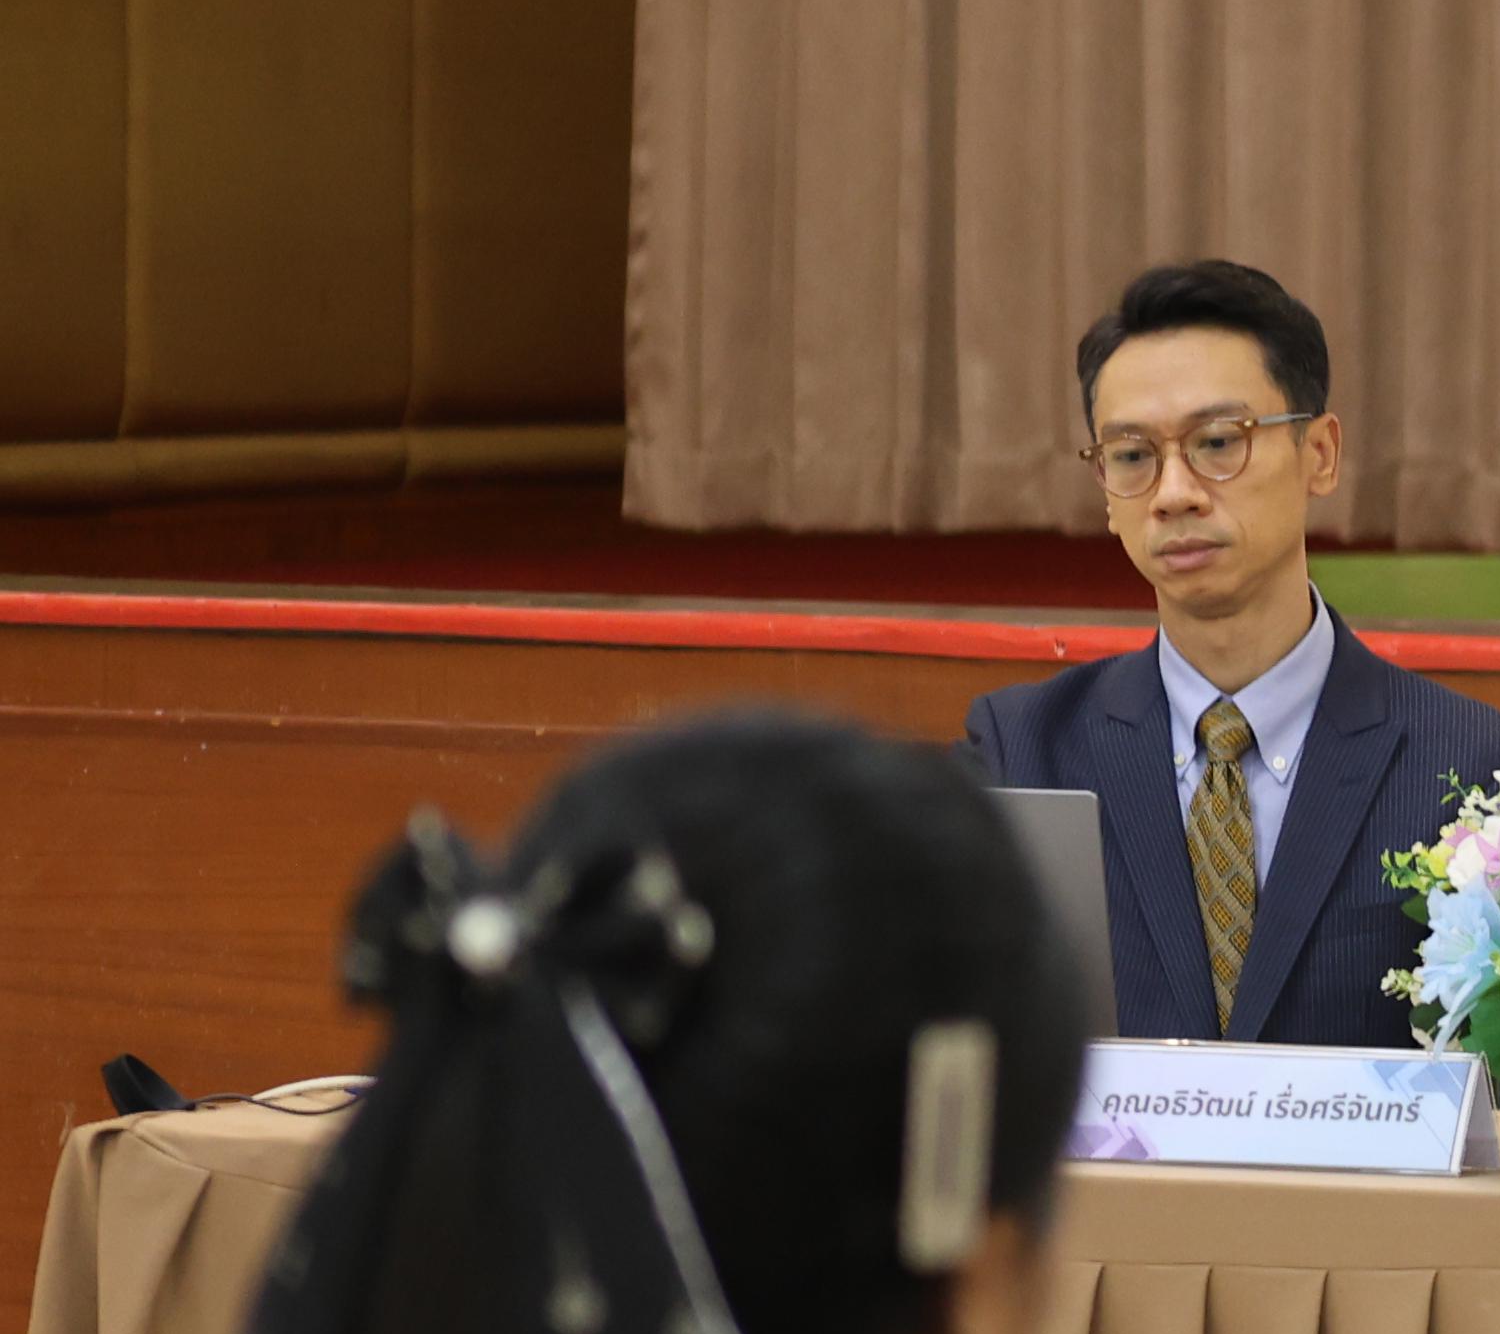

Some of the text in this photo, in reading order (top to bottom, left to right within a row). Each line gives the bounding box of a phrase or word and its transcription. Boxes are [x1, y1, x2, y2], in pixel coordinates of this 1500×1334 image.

[1102, 1088, 1257, 1123] คุณอธิวัฒน์
